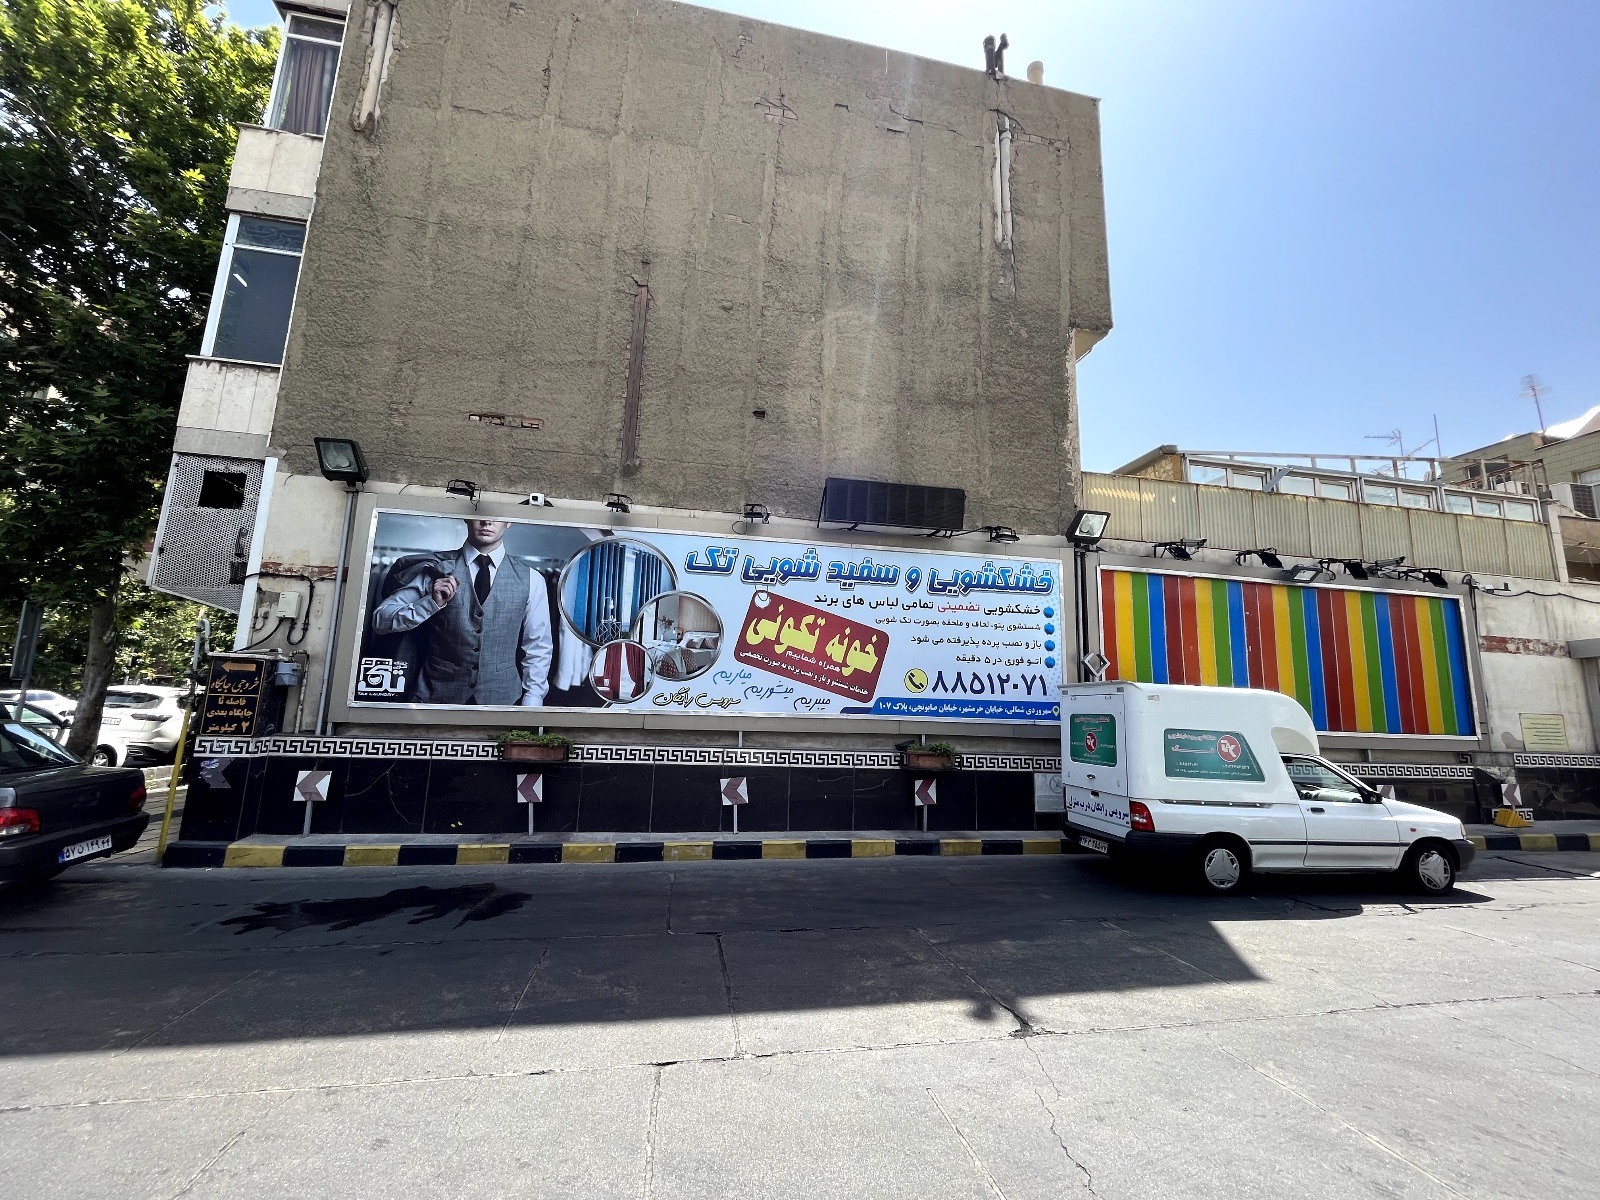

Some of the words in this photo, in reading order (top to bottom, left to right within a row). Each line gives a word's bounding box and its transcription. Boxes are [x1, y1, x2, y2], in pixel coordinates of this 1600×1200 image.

[685, 546, 739, 576] تک
[741, 548, 822, 585] شویی
[826, 557, 900, 590] سفید
[927, 561, 1054, 597] خشکشویی
[905, 567, 922, 594] و
[814, 594, 839, 606] برند
[842, 594, 865, 609] های
[869, 597, 898, 610] لباس
[901, 599, 934, 610] تمامی
[937, 601, 980, 613] تضمینی
[983, 603, 1041, 616] خشکشویی
[746, 604, 826, 654] تکونی
[911, 634, 929, 645] شود
[932, 638, 945, 647] می
[946, 636, 980, 649] پذیرفته
[981, 640, 1000, 650] پرده
[1002, 639, 1023, 648] نصب
[1031, 640, 1042, 650] باز
[825, 627, 879, 676] خونه
[956, 653, 981, 664] دقیقه
[992, 658, 1002, 667] در
[1004, 656, 1024, 667] فوری
[231, 677, 259, 693] خروجی
[931, 670, 1048, 696] ۸۸۵۱۲۰۷۱
[225, 697, 246, 706] فاصله
[652, 686, 694, 708] رایگان
[695, 692, 741, 709] سرویس
[206, 708, 228, 718] بعدی
[892, 702, 908, 712] پلاک
[939, 703, 958, 713] خیابان
[984, 705, 1003, 715] خیابان
[228, 708, 253, 719] جایگاه
